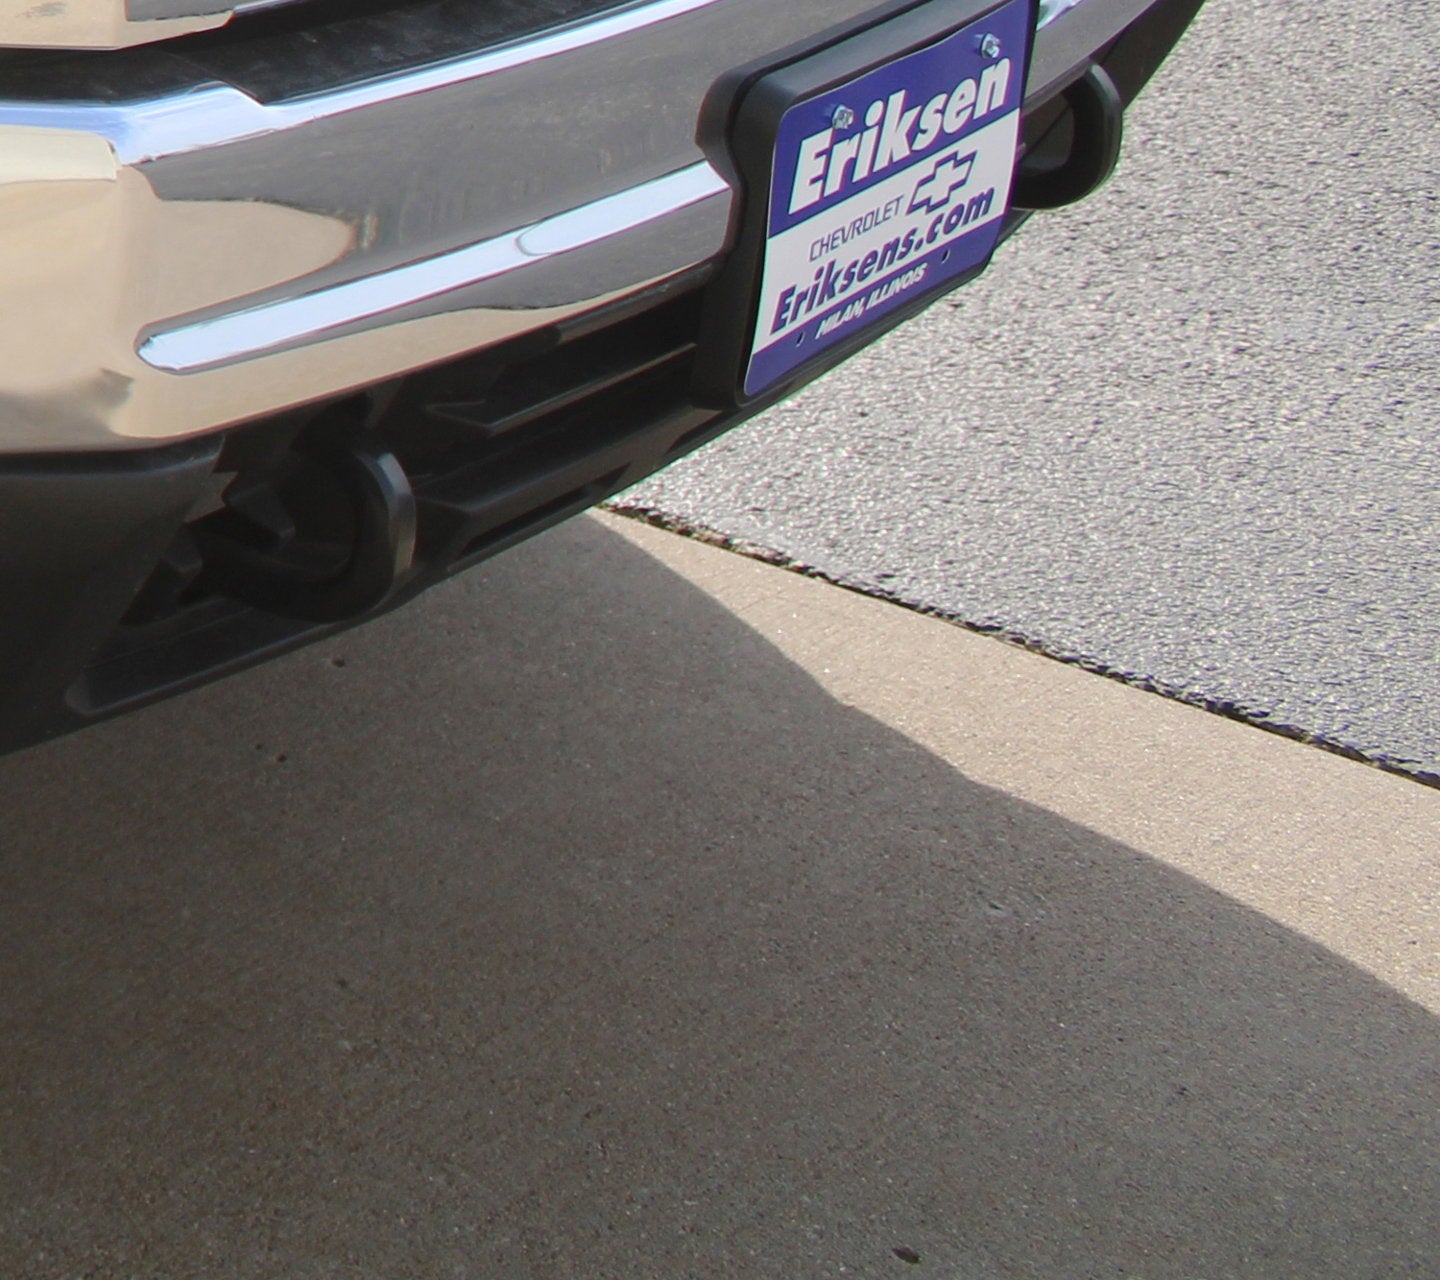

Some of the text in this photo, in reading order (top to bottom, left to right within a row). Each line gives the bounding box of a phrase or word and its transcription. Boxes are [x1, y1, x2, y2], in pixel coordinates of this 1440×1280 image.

[789, 57, 1011, 215] Eriksen
[770, 186, 994, 335] Eriksens.com
[809, 195, 904, 262] CHEVROLET
[815, 263, 926, 339] MILAN, ILLINOIS
